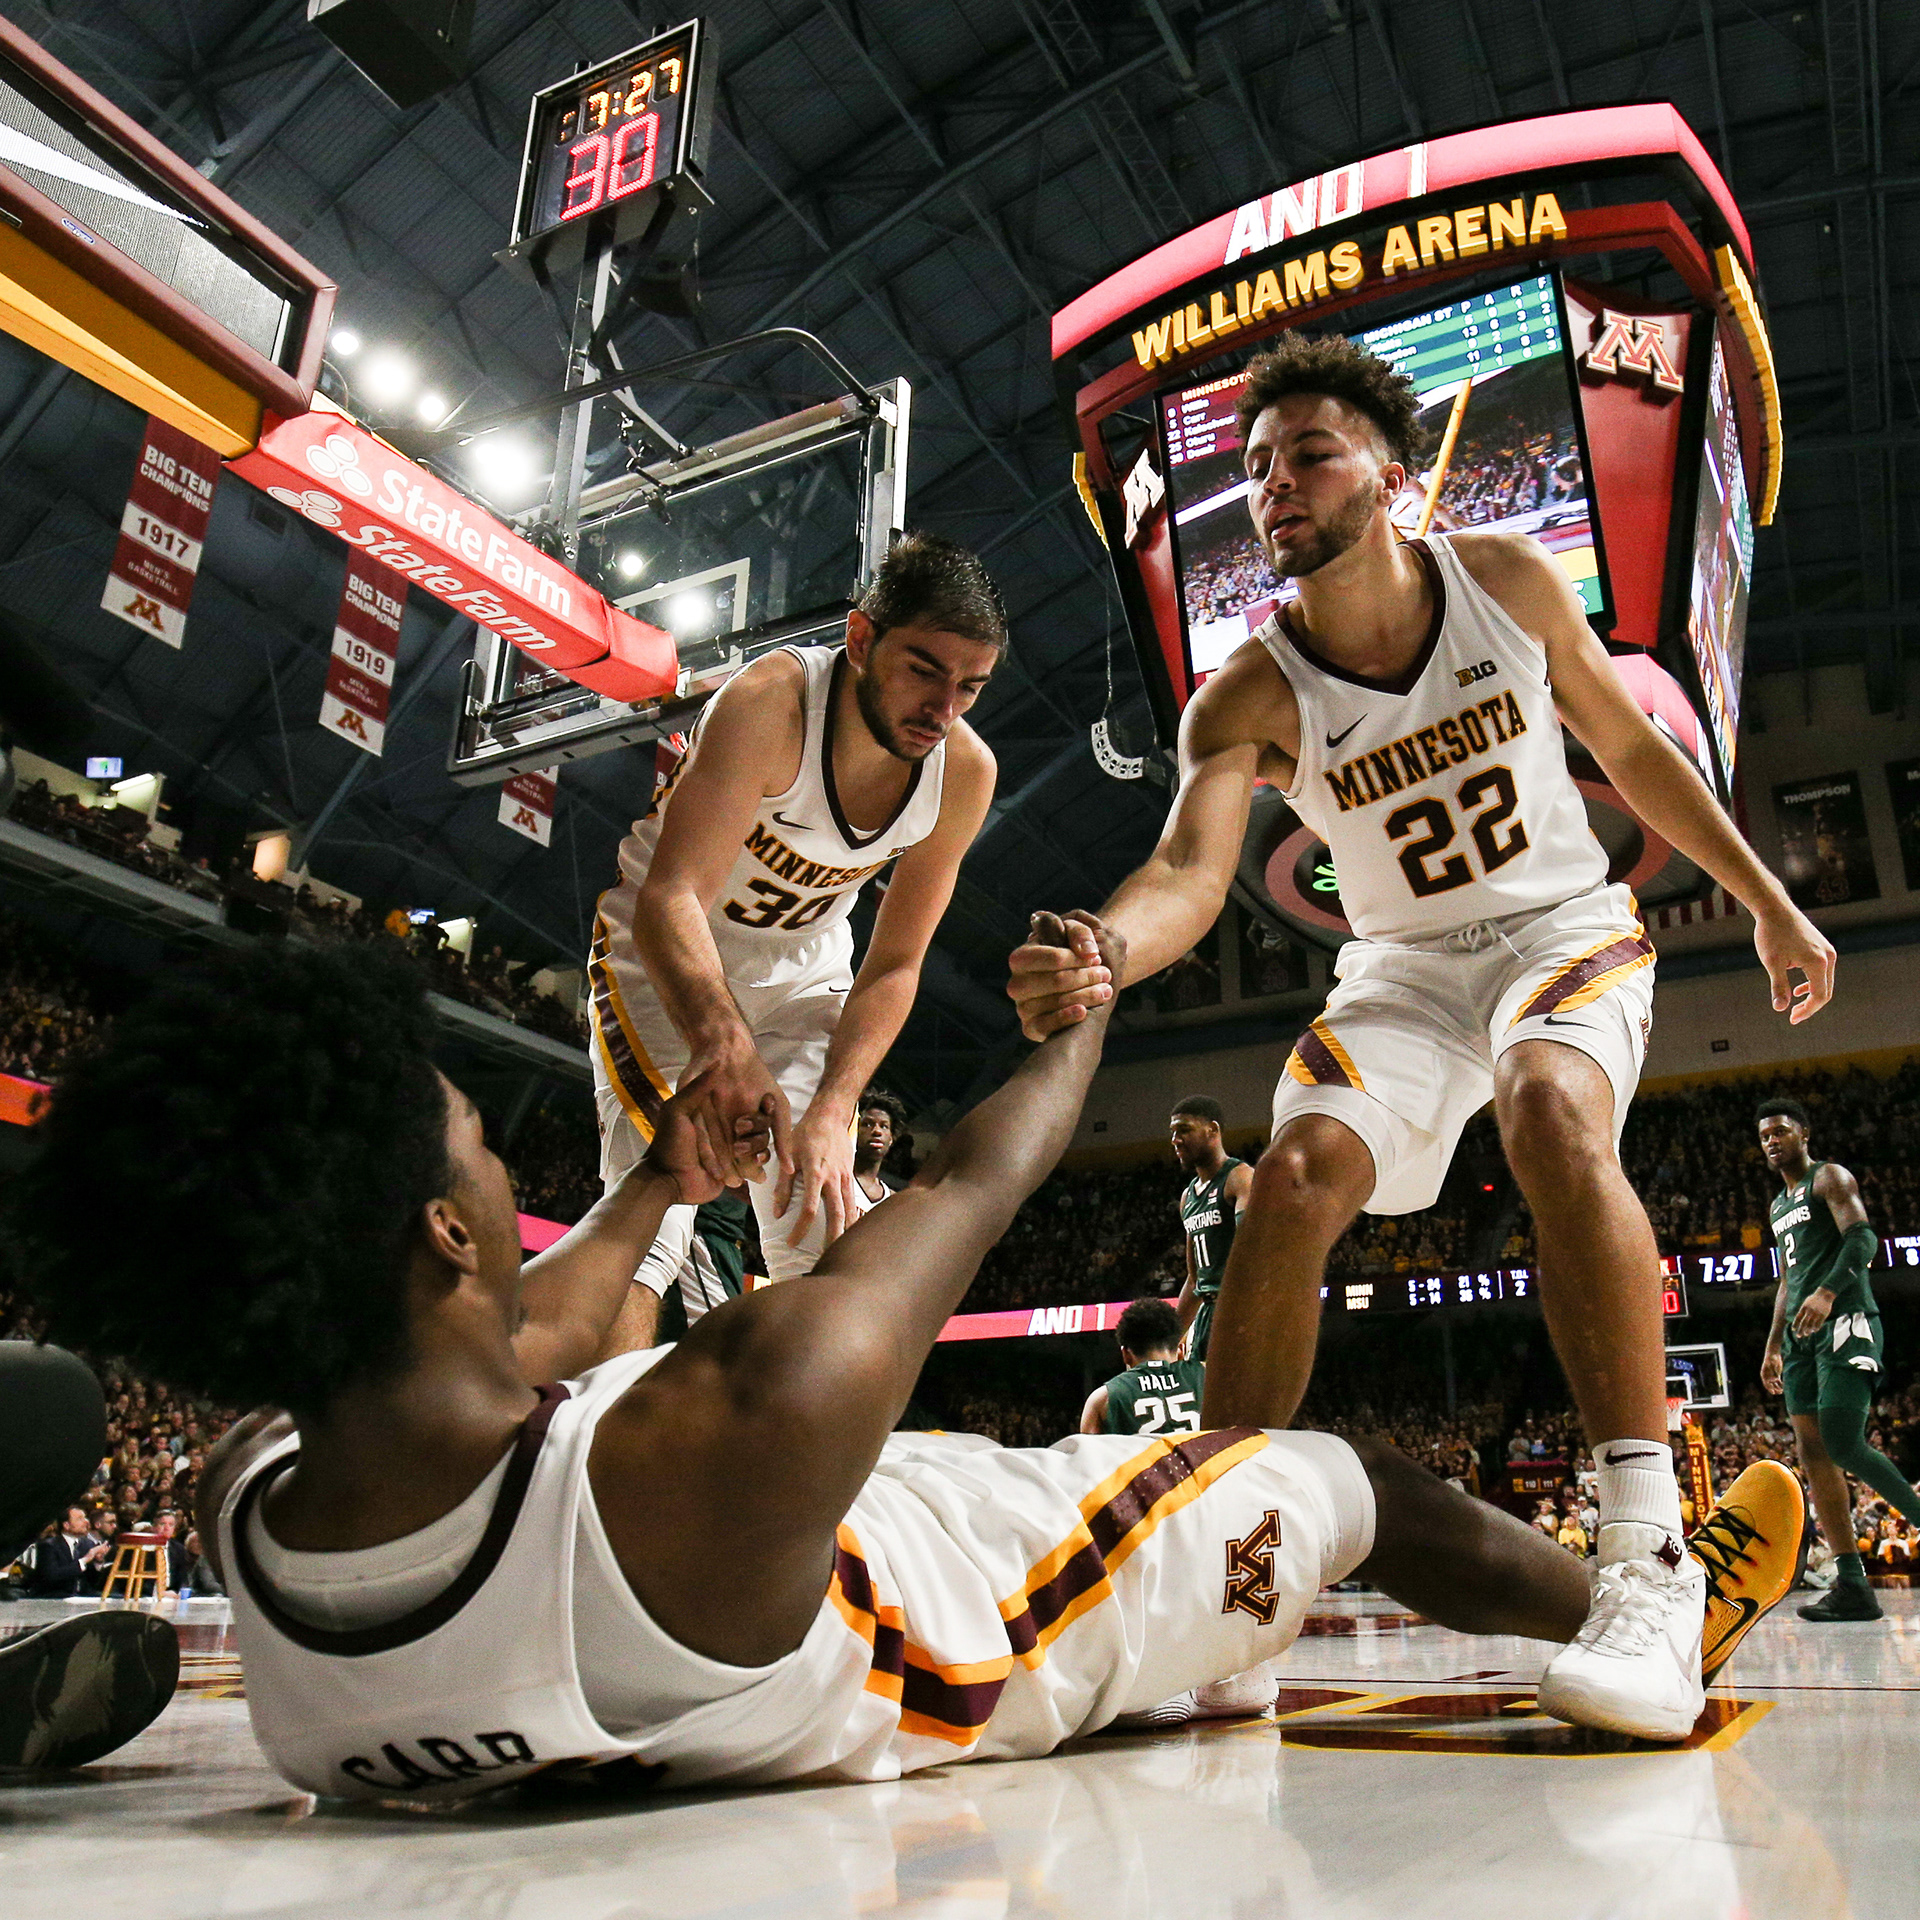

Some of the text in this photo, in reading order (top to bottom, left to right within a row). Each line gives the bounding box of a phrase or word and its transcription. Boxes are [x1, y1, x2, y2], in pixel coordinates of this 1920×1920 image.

[588, 57, 682, 127] 7:27
[560, 112, 660, 221] 30
[1224, 142, 1427, 266] AND 1
[1131, 193, 1568, 370] WILLIAMS ARENA
[1363, 276, 1546, 344] MICHIGAN ST P A R F
[1462, 325, 1479, 338] 13
[1517, 310, 1527, 322] 3
[1541, 303, 1551, 314] 2
[1516, 299, 1523, 309] 1
[1467, 349, 1481, 363] 11
[1494, 343, 1503, 354] 4
[1545, 327, 1556, 340] 3
[1492, 330, 1502, 342] 2
[1519, 322, 1529, 333] 4
[1543, 315, 1551, 326] 1
[1472, 361, 1480, 373] 7
[1495, 355, 1503, 366] 1
[1547, 339, 1558, 351] 3
[1587, 308, 1684, 393] M
[1182, 372, 1253, 401] MINNESOTA
[1167, 429, 1181, 442] 22
[1182, 412, 1206, 426] Carr
[140, 463, 210, 513] CHAMPIONS
[145, 444, 212, 499] BIG TEN
[138, 517, 189, 559] 1917
[345, 591, 400, 632] CHAMPIONS
[348, 574, 402, 619] BIG TEN
[345, 640, 385, 675] 1919
[1321, 689, 1527, 812] MINNESOTA
[1783, 784, 1851, 804] THOMPSON
[1383, 763, 1531, 898] 22
[722, 876, 851, 931] 30
[1194, 1233, 1211, 1268] 11
[1784, 1232, 1797, 1267] 2
[1906, 1248, 1919, 1266] 8
[1698, 1254, 1753, 1283] 7:27
[1345, 1284, 1373, 1298] MINN
[1346, 1297, 1369, 1310] MSU
[1429, 1291, 1441, 1305] 14
[1515, 1280, 1526, 1296] 2
[1663, 1290, 1680, 1314] 0
[1027, 1303, 1106, 1336] AND 1
[1137, 1373, 1180, 1392] HALL
[1134, 1392, 1201, 1434] 25
[1689, 1447, 1706, 1522] MINNESOT
[340, 1731, 537, 1791] CARR
